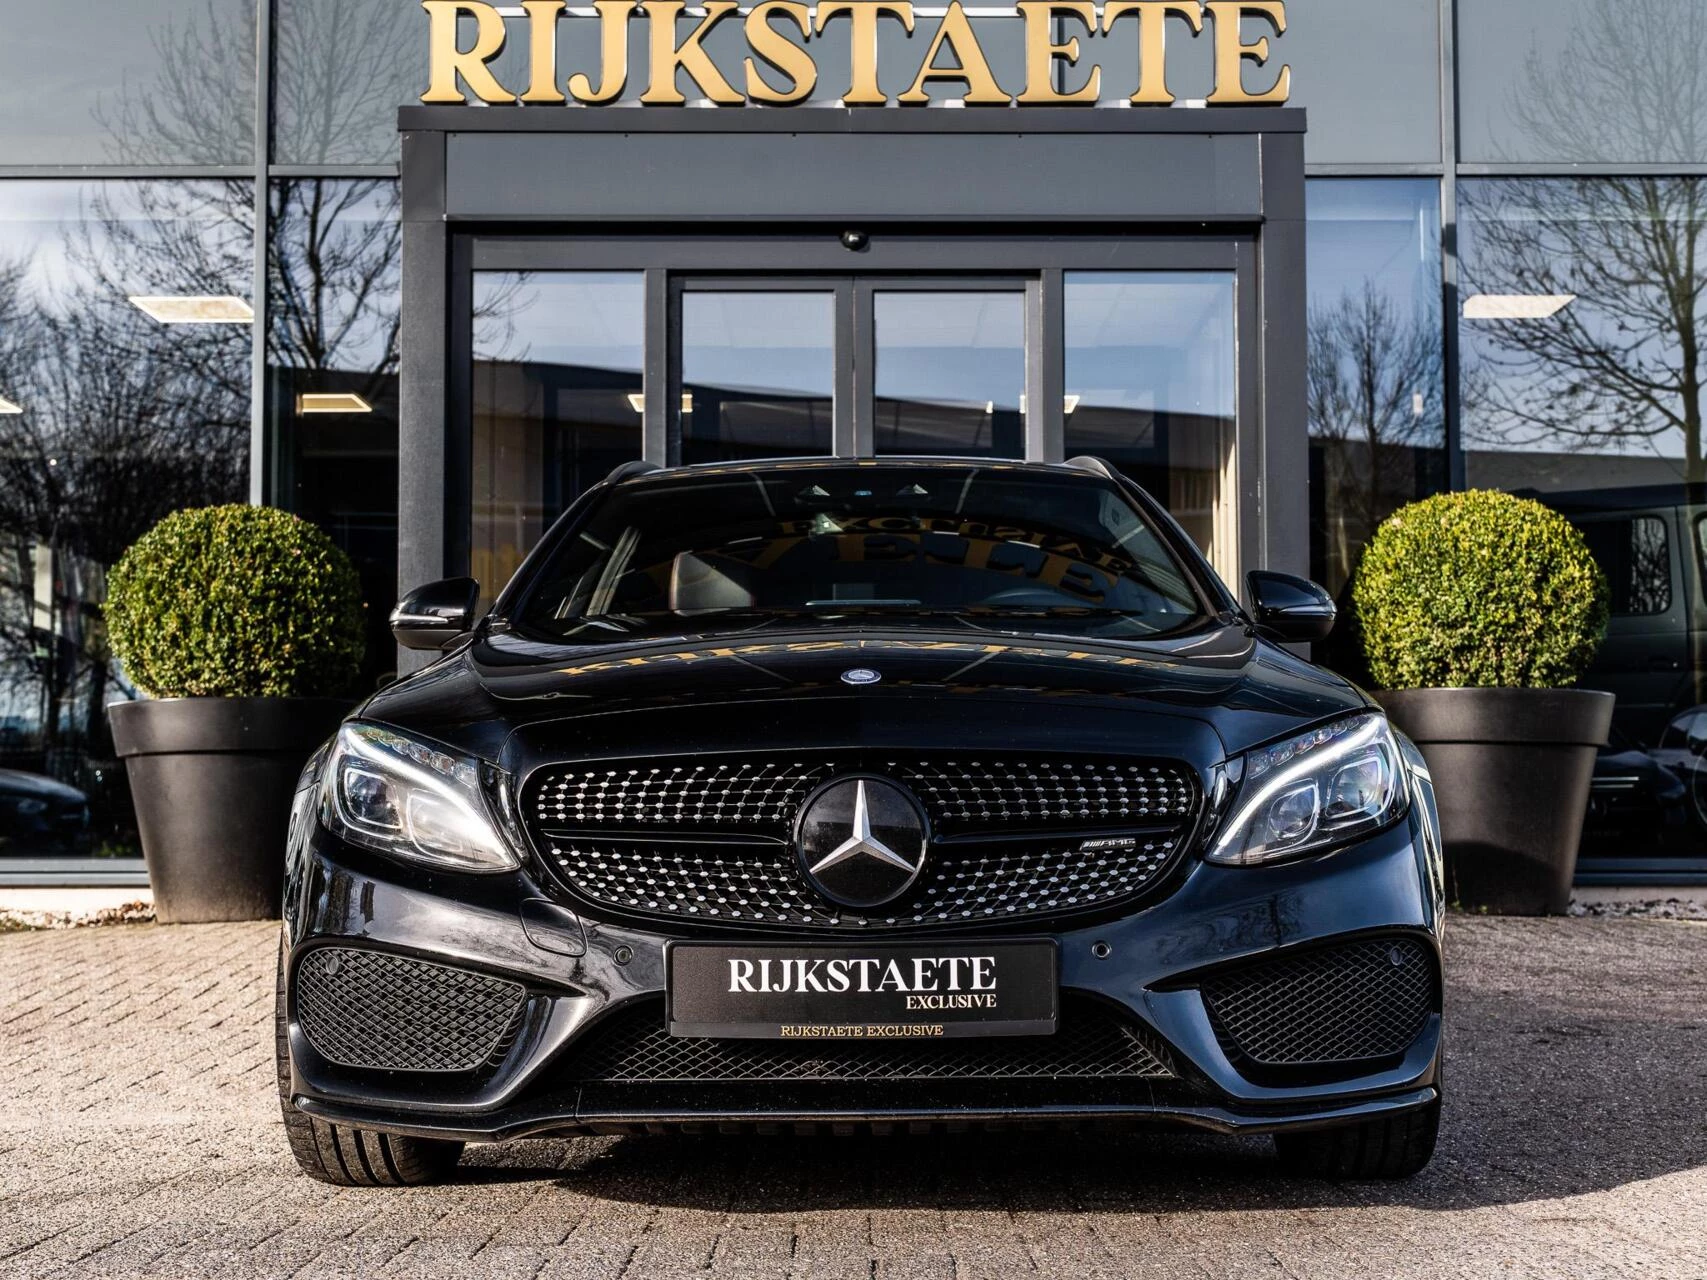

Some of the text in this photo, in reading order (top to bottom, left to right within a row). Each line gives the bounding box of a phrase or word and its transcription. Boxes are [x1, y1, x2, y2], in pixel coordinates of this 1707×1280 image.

[422, 0, 1292, 107] RIJKSTAETE
[728, 956, 997, 993] RIJKSTAETE
[906, 994, 997, 1010] EXCLUSIVE
[780, 1025, 944, 1037] RIJKSTAETE EXCLUSIVE
